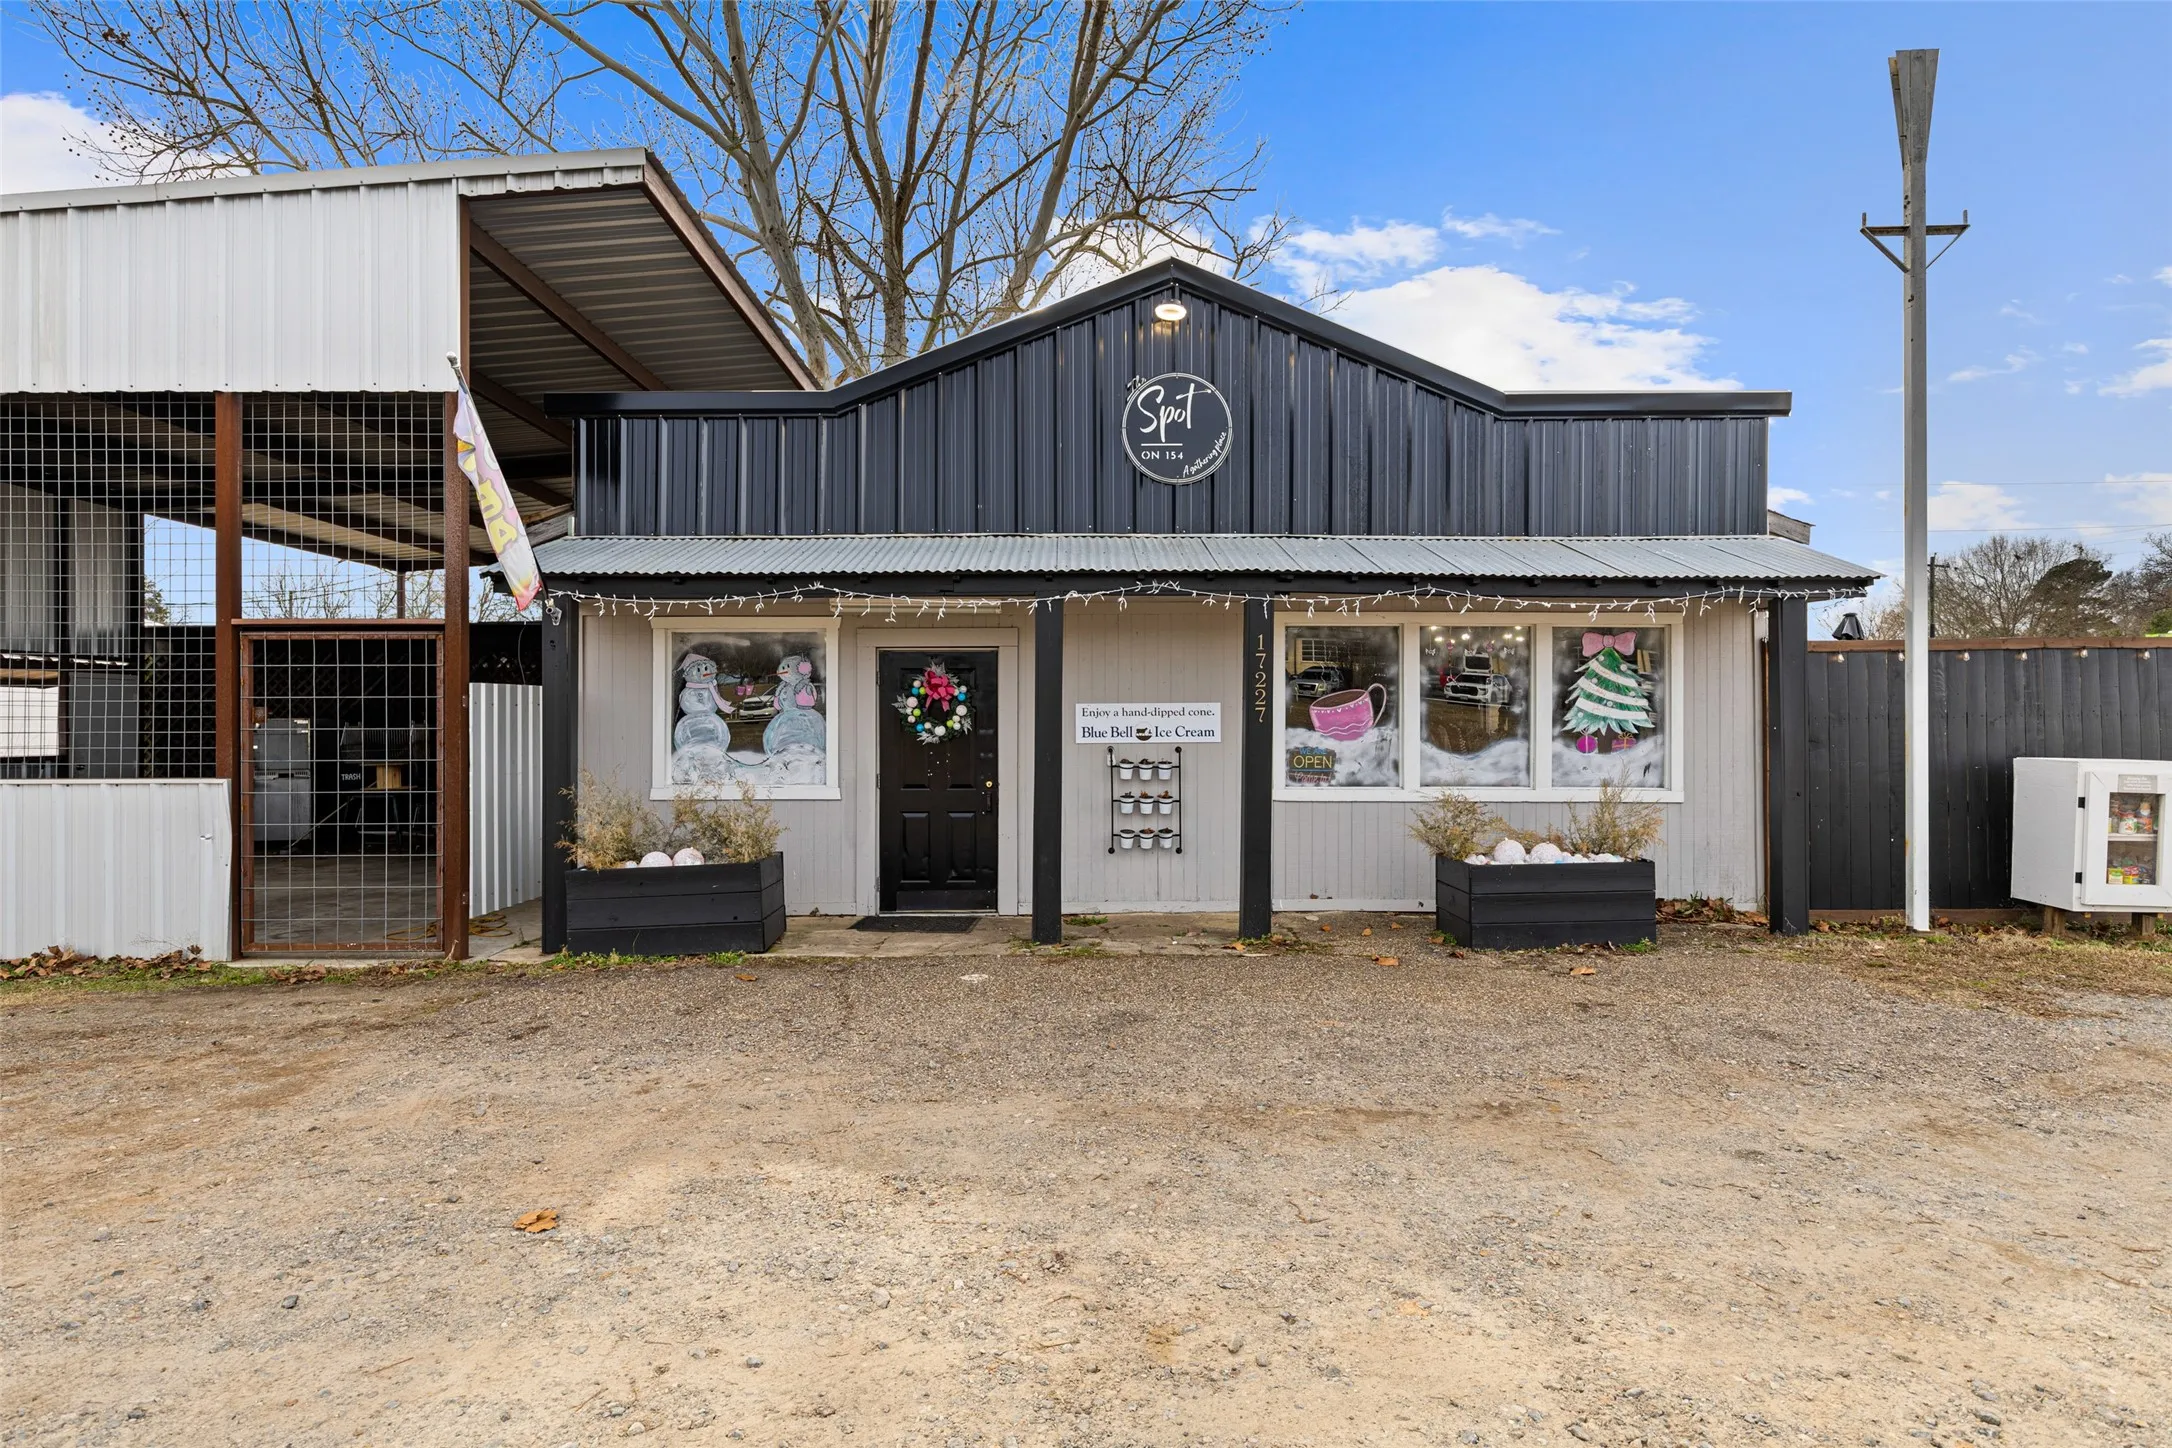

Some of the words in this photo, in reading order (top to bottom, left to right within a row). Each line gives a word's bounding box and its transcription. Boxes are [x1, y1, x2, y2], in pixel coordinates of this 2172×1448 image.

[1137, 382, 1212, 443] Spot
[1141, 450, 1160, 460] ON
[1165, 450, 1184, 460] 154
[1255, 633, 1267, 723] 17227
[1082, 707, 1111, 719] Enjoy
[1122, 706, 1185, 719] hand-dipped
[1188, 709, 1215, 717] cone.
[1082, 726, 1108, 738] Blue
[1110, 726, 1133, 738] Bell
[1154, 725, 1172, 738] Ice
[1175, 725, 1215, 738] Cream
[1293, 755, 1333, 769] OPEN
[340, 772, 362, 781] TRASH
